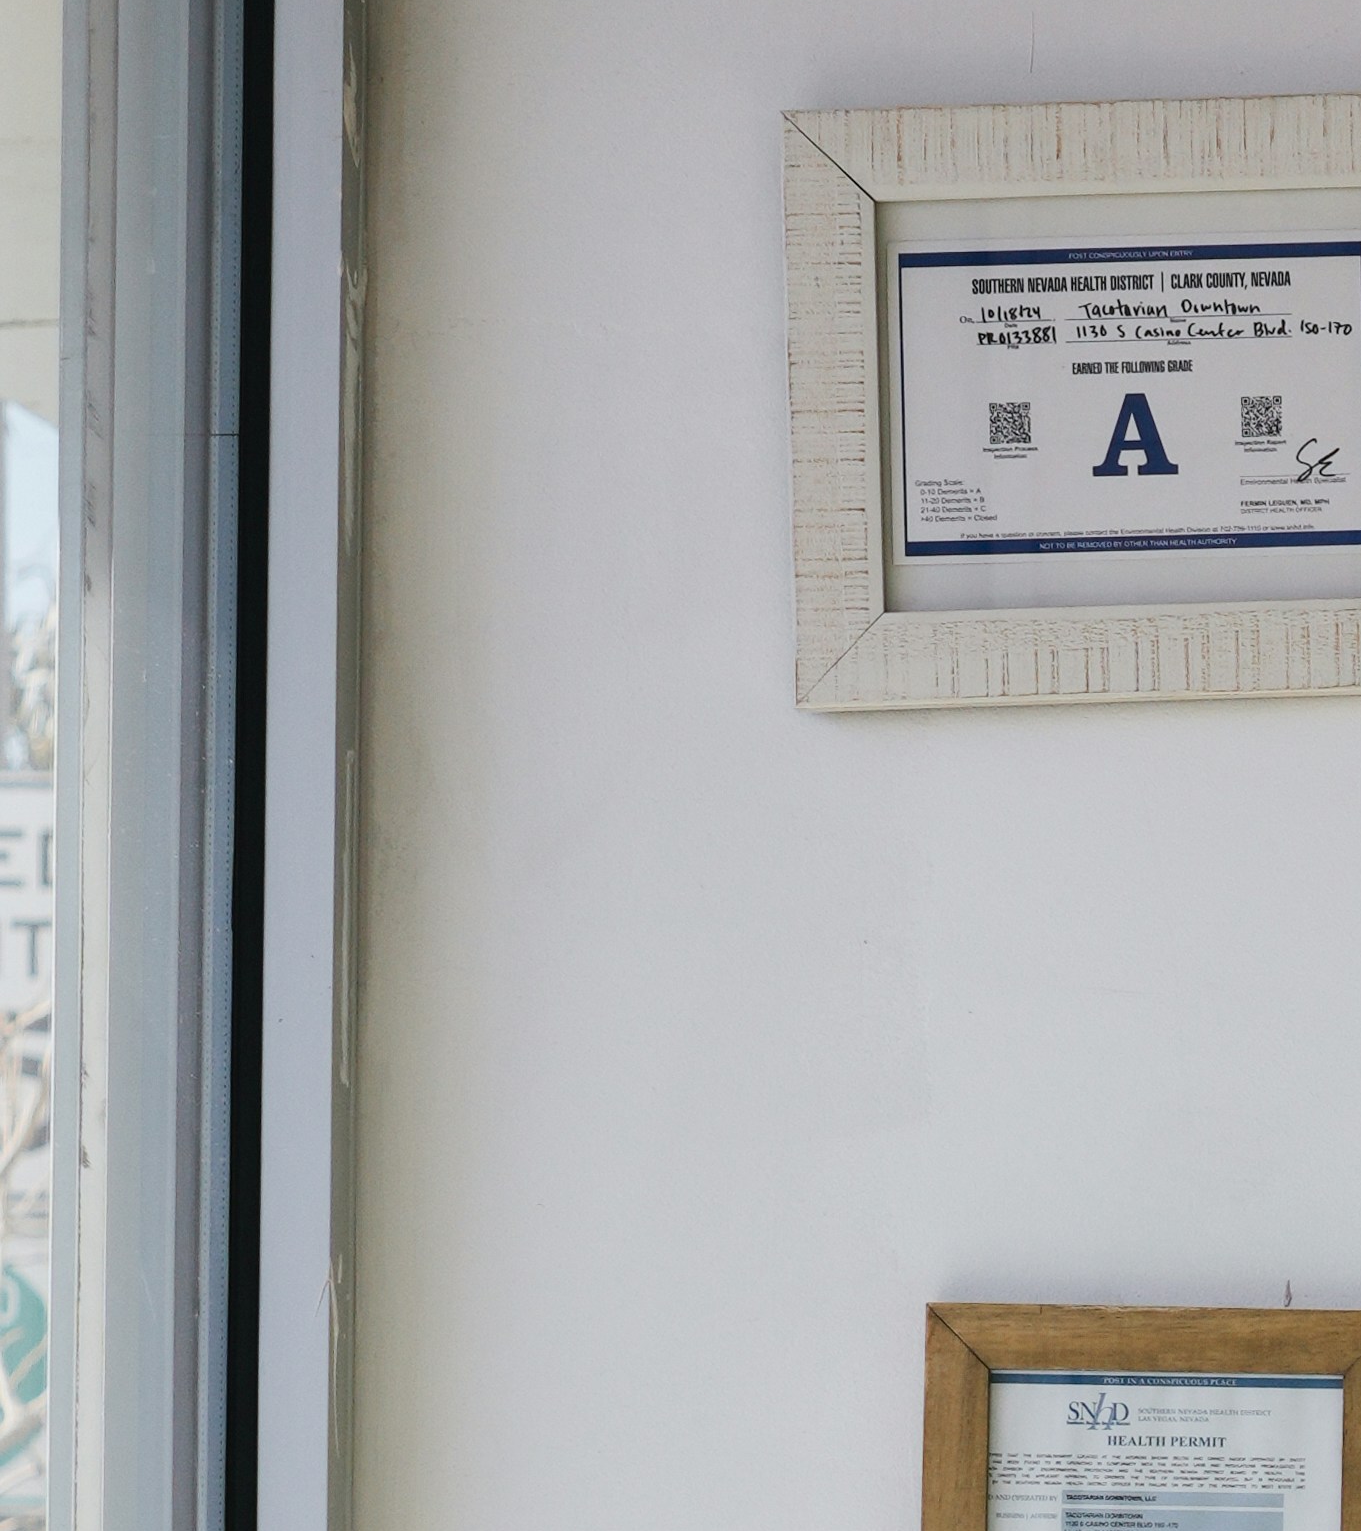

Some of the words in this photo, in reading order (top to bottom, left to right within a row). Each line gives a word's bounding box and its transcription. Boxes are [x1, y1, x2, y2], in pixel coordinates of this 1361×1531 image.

[972, 278, 1024, 294] SOUTHERN
[1028, 277, 1067, 292] NEVADA
[1071, 276, 1106, 291] HEALTH
[1110, 275, 1154, 290] DISTRICT
[1171, 273, 1203, 289] CLARK
[1206, 272, 1247, 290] COUNTY,
[1251, 271, 1291, 287] NEVADA
[982, 305, 1040, 322] 10/18/24
[1077, 301, 1168, 319] Tacotarian
[1181, 299, 1260, 316] Downtown
[1077, 325, 1107, 338] 1130
[1117, 325, 1125, 338] S
[1135, 322, 1182, 338] Casino
[1187, 321, 1245, 338] Center
[1254, 319, 1291, 338] Blvd.
[1072, 362, 1102, 374] EARNED
[1105, 362, 1119, 374] THE
[1122, 360, 1165, 373] FOLLOWING
[1168, 360, 1192, 372] GRADE
[1093, 393, 1178, 477] A
[1107, 1435, 1166, 1447] HEALTH
[1170, 1436, 1227, 1448] PERMIT
